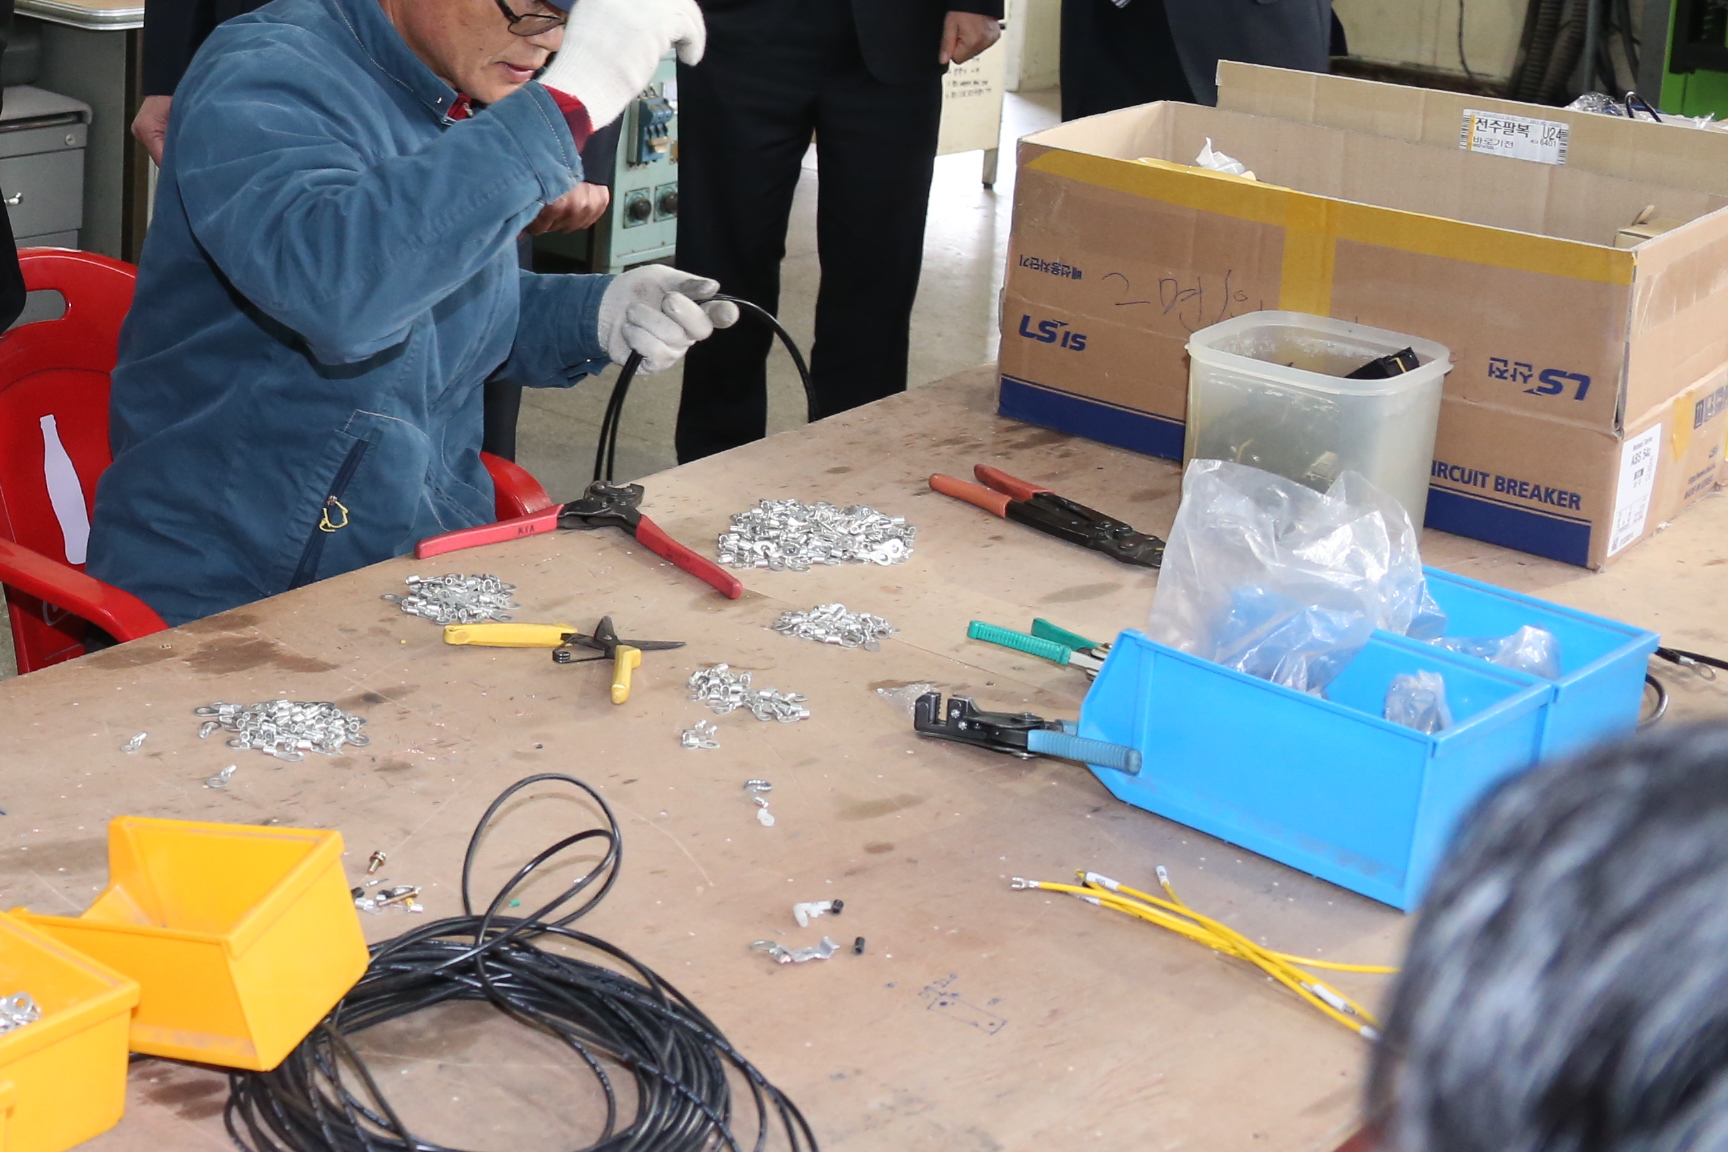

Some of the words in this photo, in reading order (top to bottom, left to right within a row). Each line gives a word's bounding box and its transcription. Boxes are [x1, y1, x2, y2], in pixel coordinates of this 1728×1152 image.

[1475, 117, 1530, 138] 전주팔복
[1430, 459, 1490, 489] IRCUIT
[1494, 474, 1582, 511] BREAKER
